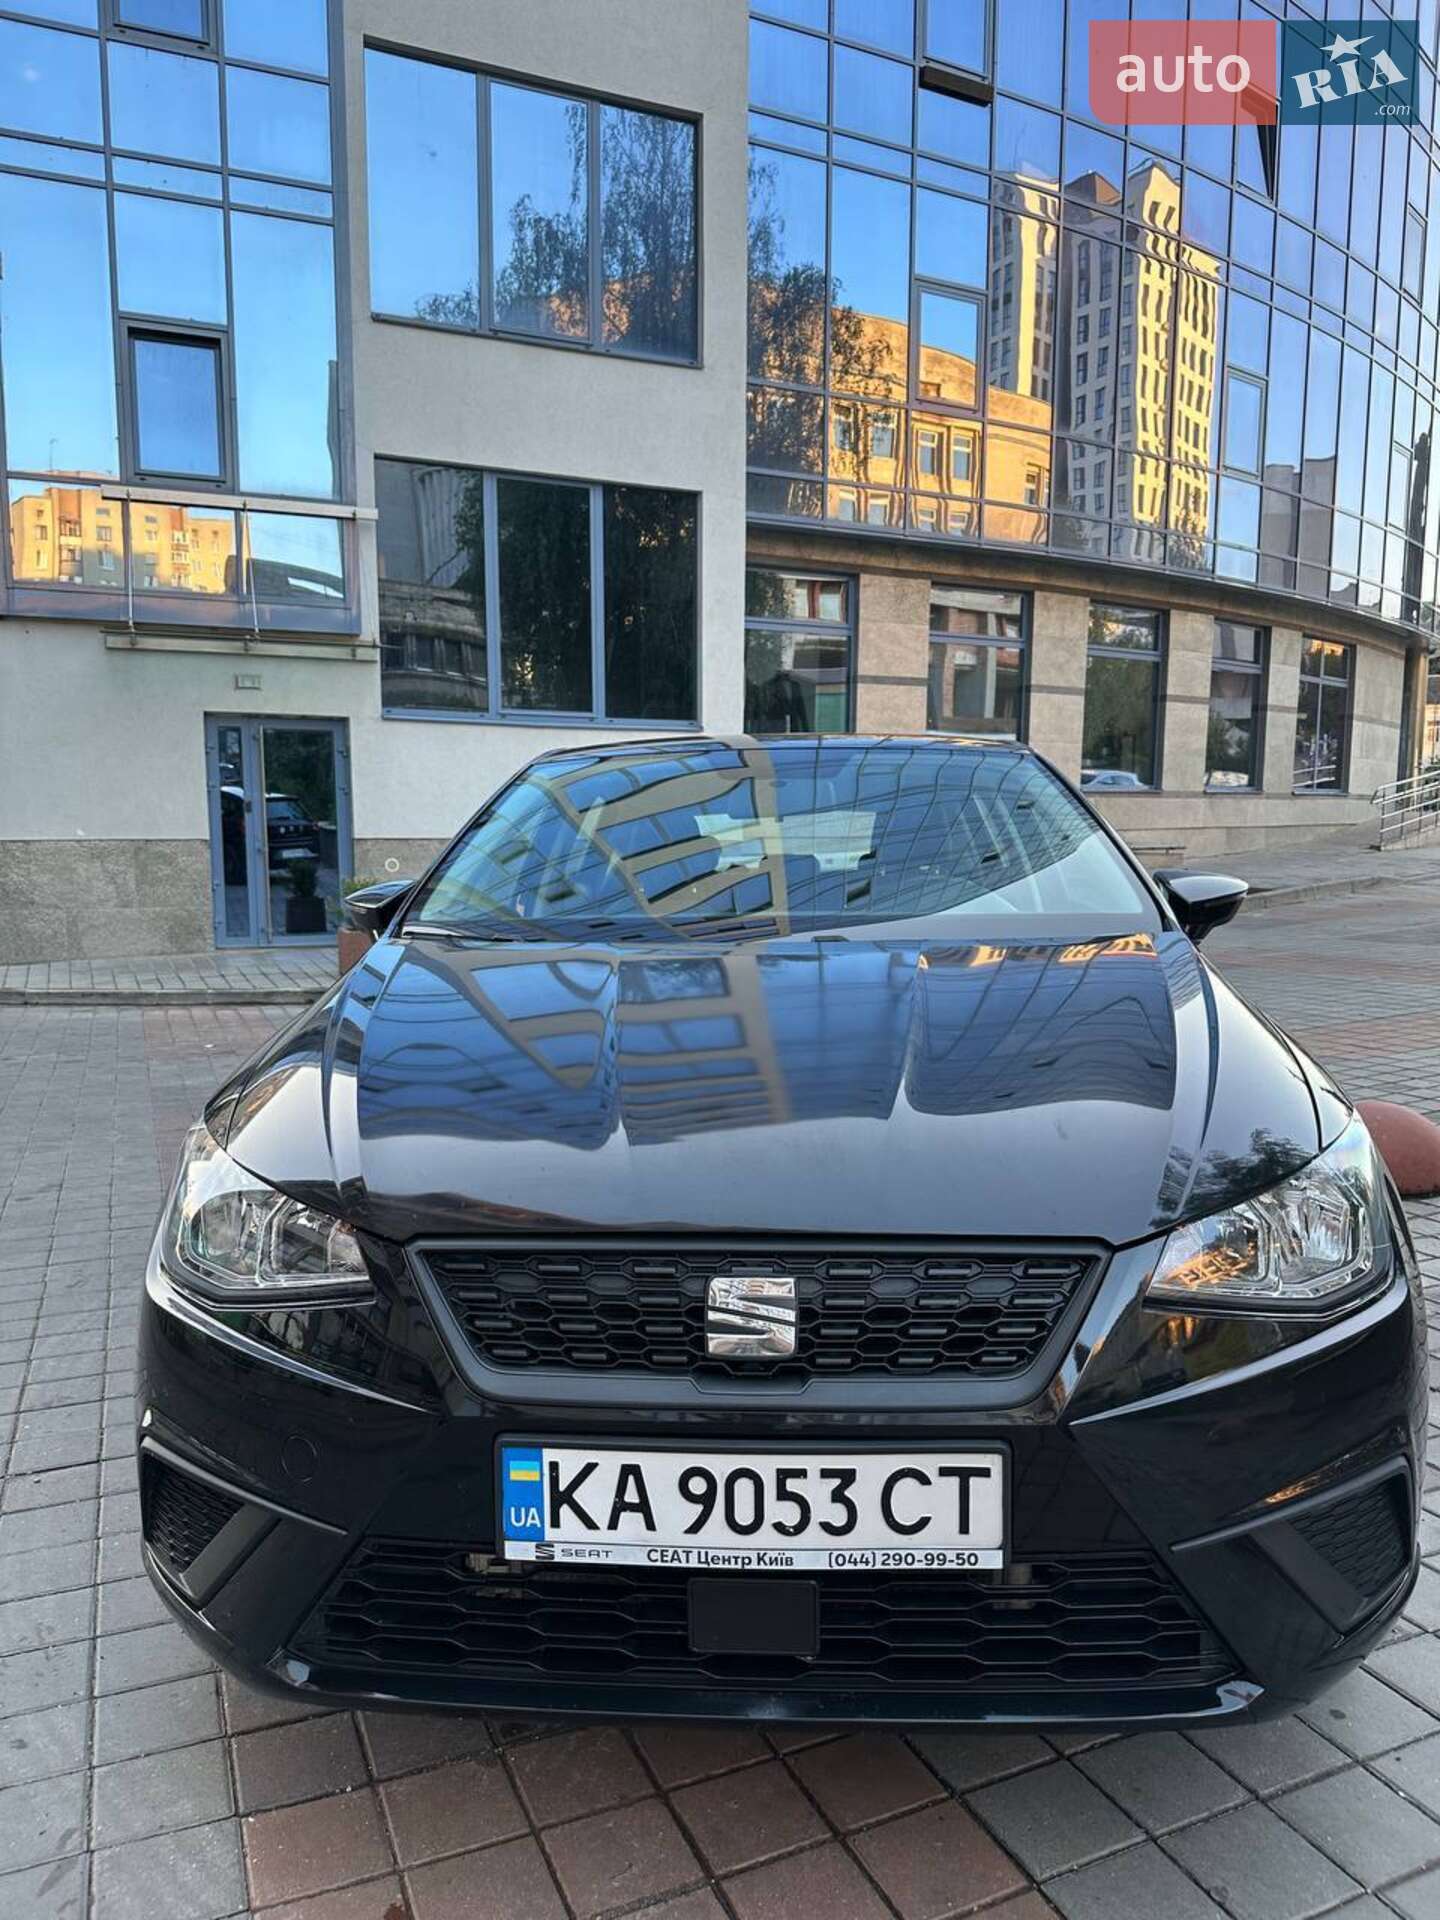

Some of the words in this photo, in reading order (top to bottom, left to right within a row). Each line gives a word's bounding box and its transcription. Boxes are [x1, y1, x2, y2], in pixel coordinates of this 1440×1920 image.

[547, 1461, 657, 1532] KA
[677, 1466, 858, 1536] 9053
[880, 1466, 992, 1536] CT
[509, 1507, 542, 1528] UA
[560, 1548, 613, 1559] SEAT
[697, 1551, 752, 1569] Центр
[757, 1552, 794, 1567] Київ
[828, 1553, 877, 1569] (044)
[881, 1554, 978, 1567] 290-99-50
